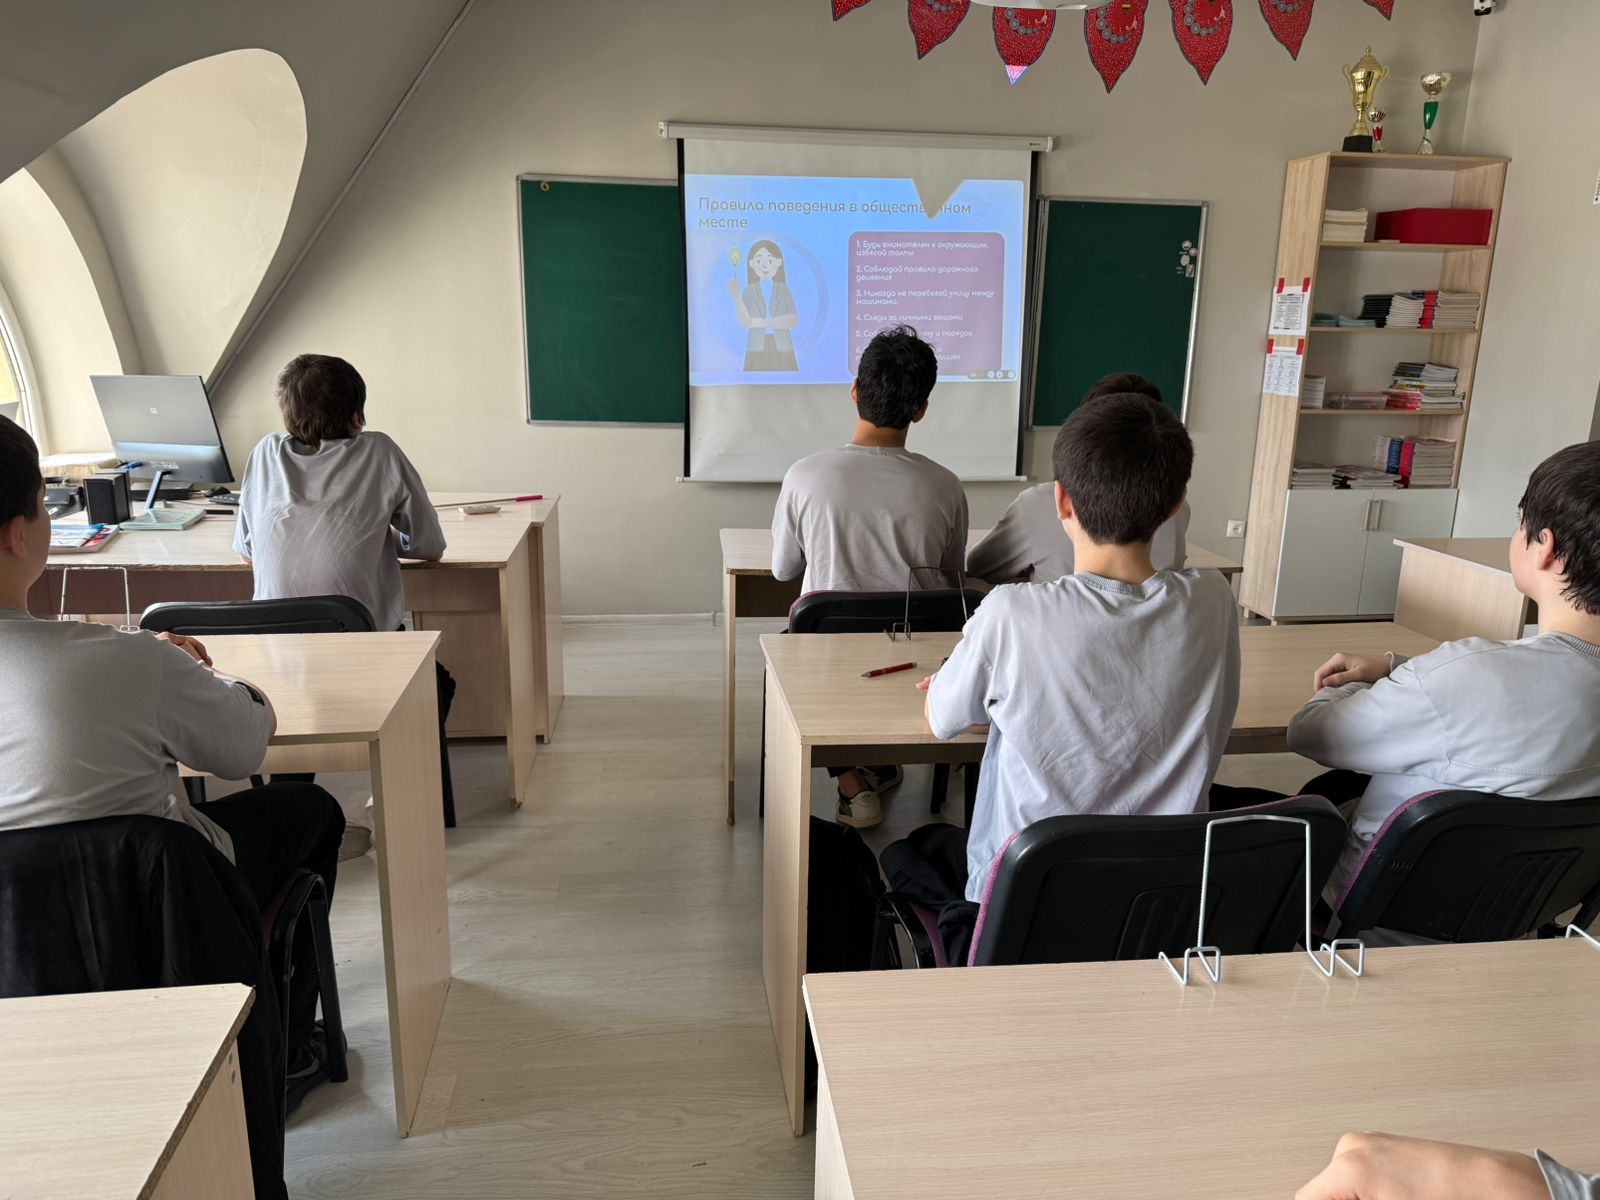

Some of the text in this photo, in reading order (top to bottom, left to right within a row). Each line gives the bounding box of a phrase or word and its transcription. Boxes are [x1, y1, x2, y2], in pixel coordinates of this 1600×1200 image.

[698, 197, 971, 215] Правила поведения в обществном
[698, 217, 748, 229] месте
[863, 240, 881, 250] Будь
[882, 241, 930, 249] внимателен
[856, 248, 887, 257] избегай
[856, 264, 978, 274] 2. Соблюдай правила дорожного
[856, 289, 862, 297] 3.
[863, 289, 896, 298] Никогда
[908, 289, 947, 298] перебегай
[971, 290, 995, 298] между
[864, 313, 887, 322] Следи
[941, 330, 974, 338] порядок
